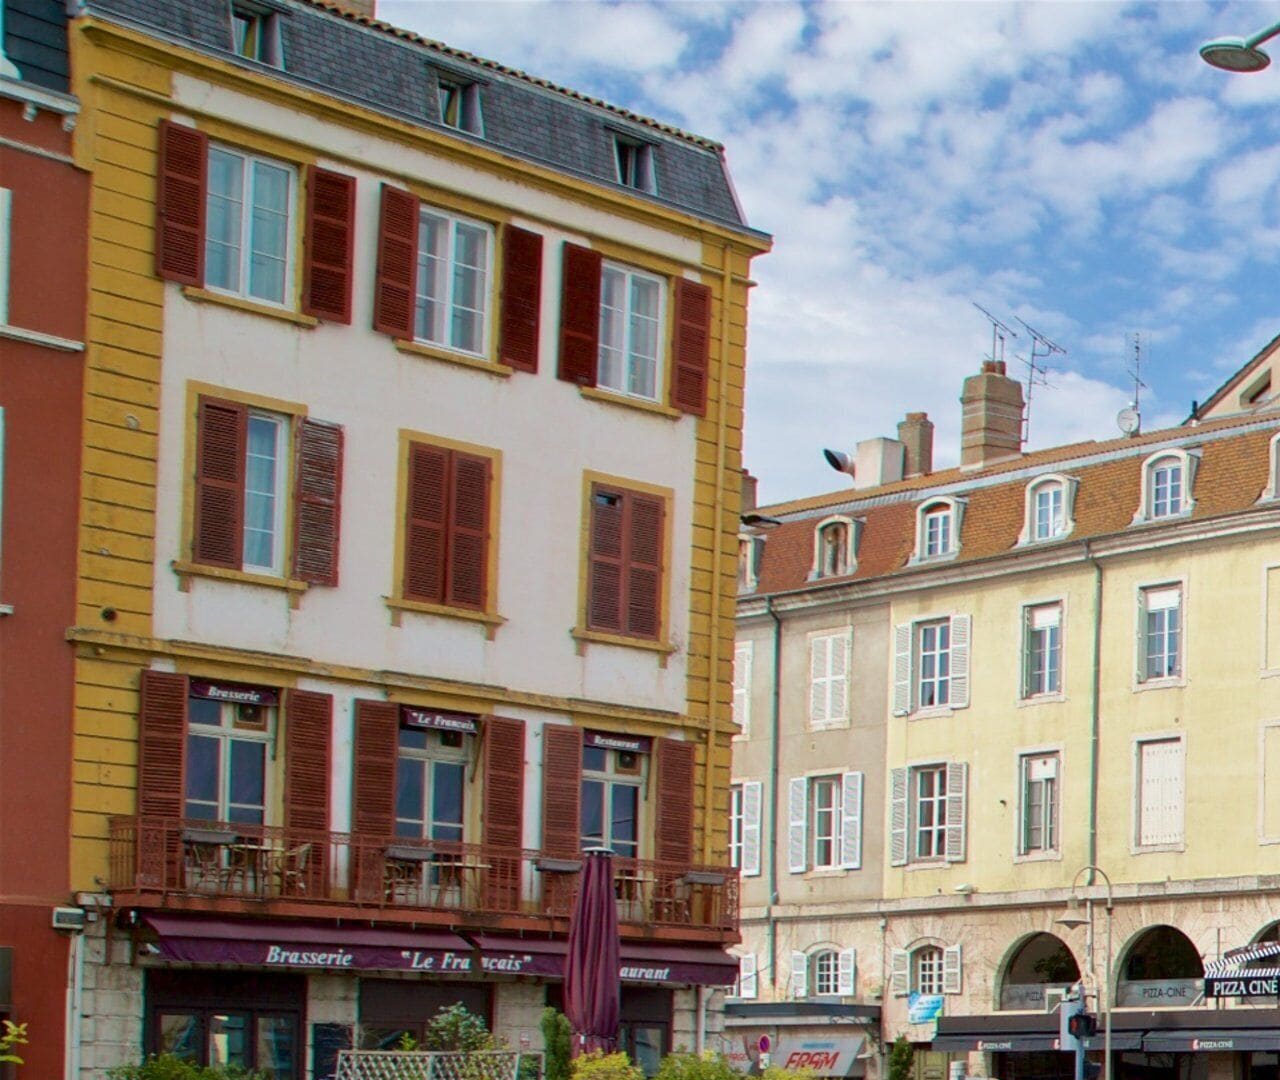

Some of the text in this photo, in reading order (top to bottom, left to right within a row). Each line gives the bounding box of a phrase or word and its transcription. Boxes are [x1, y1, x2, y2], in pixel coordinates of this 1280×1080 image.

[207, 685, 261, 702] Brasserie
[266, 945, 354, 966] Brasserie
[400, 950, 434, 969] "Le
[619, 966, 671, 980] aurant
[1213, 976, 1279, 996] PIZZA CINÉ
